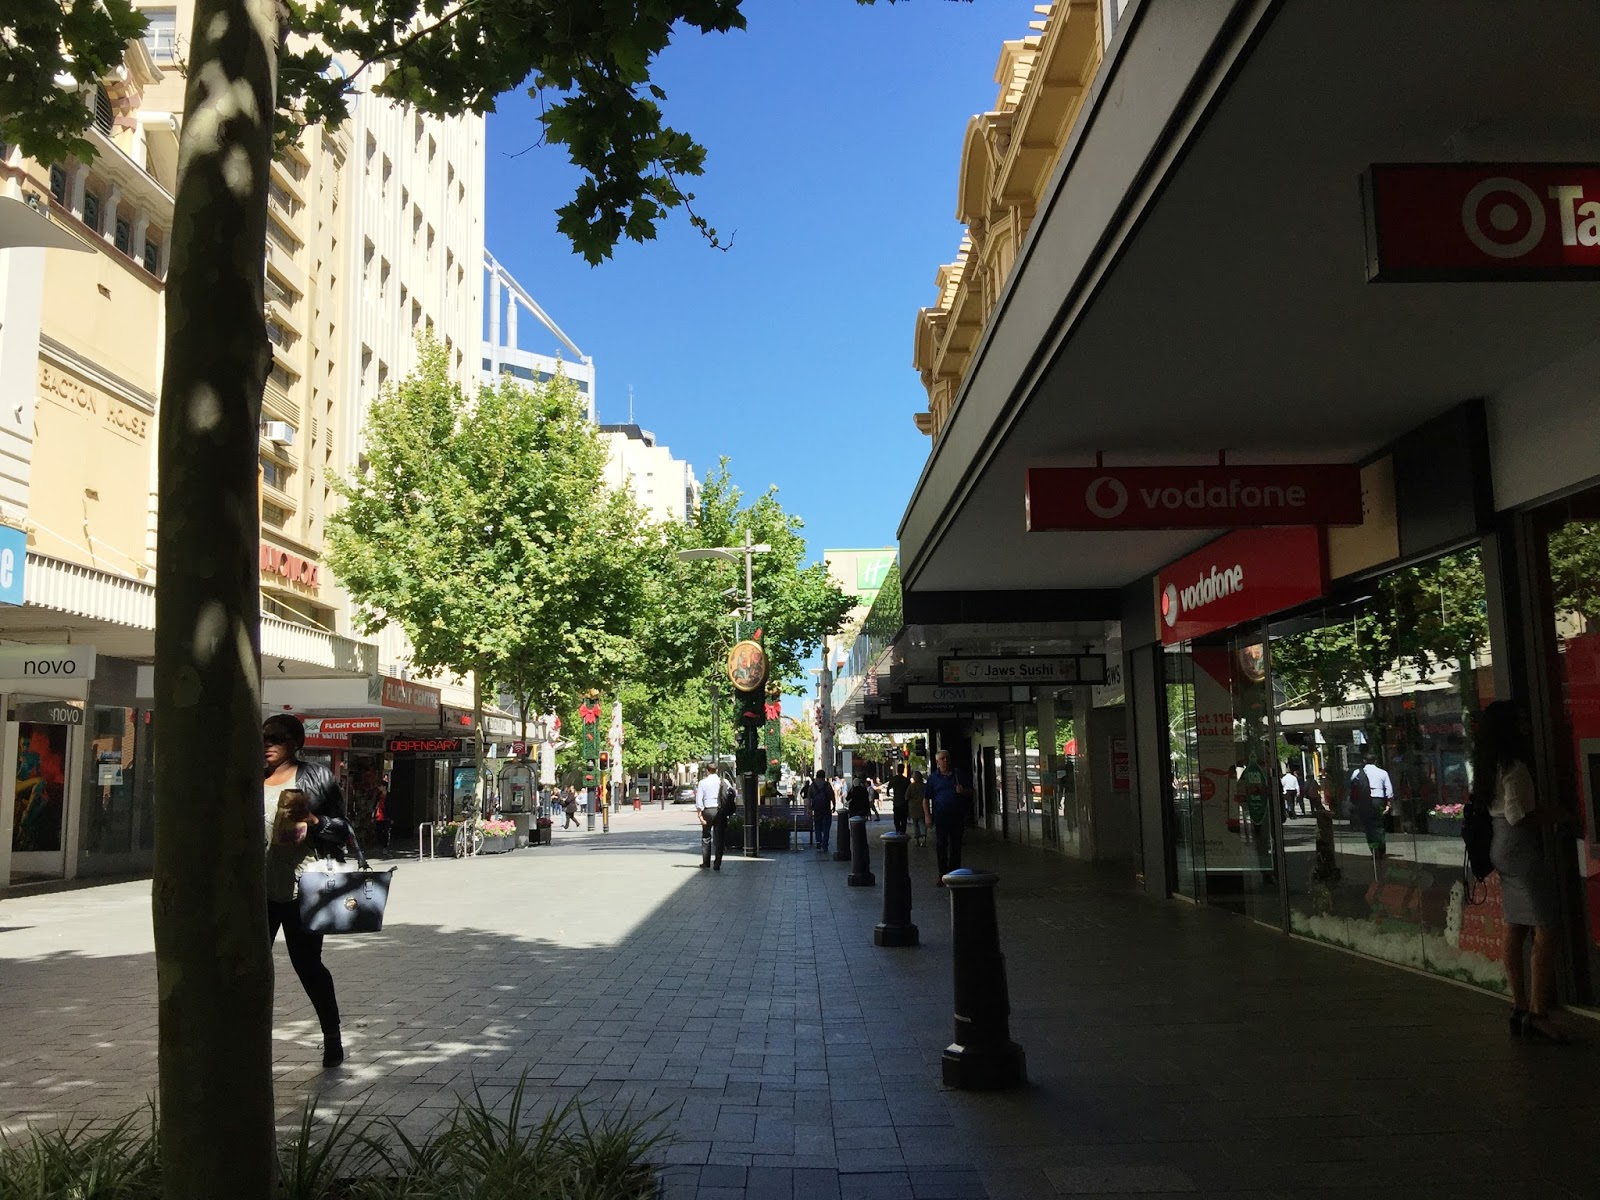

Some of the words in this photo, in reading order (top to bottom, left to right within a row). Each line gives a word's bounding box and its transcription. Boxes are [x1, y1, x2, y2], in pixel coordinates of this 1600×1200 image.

[1547, 184, 1600, 247] Ta
[1139, 479, 1306, 509] vodafone
[1180, 564, 1244, 612] vodafone
[24, 660, 76, 674] novo
[984, 664, 1016, 676] Jaws
[1019, 663, 1054, 676] Sushi
[386, 682, 413, 704] FLIGHT
[413, 688, 438, 709] CENTRE
[933, 689, 966, 700] OPSM
[52, 707, 79, 723] novo
[390, 740, 459, 751] DISPENSARY
